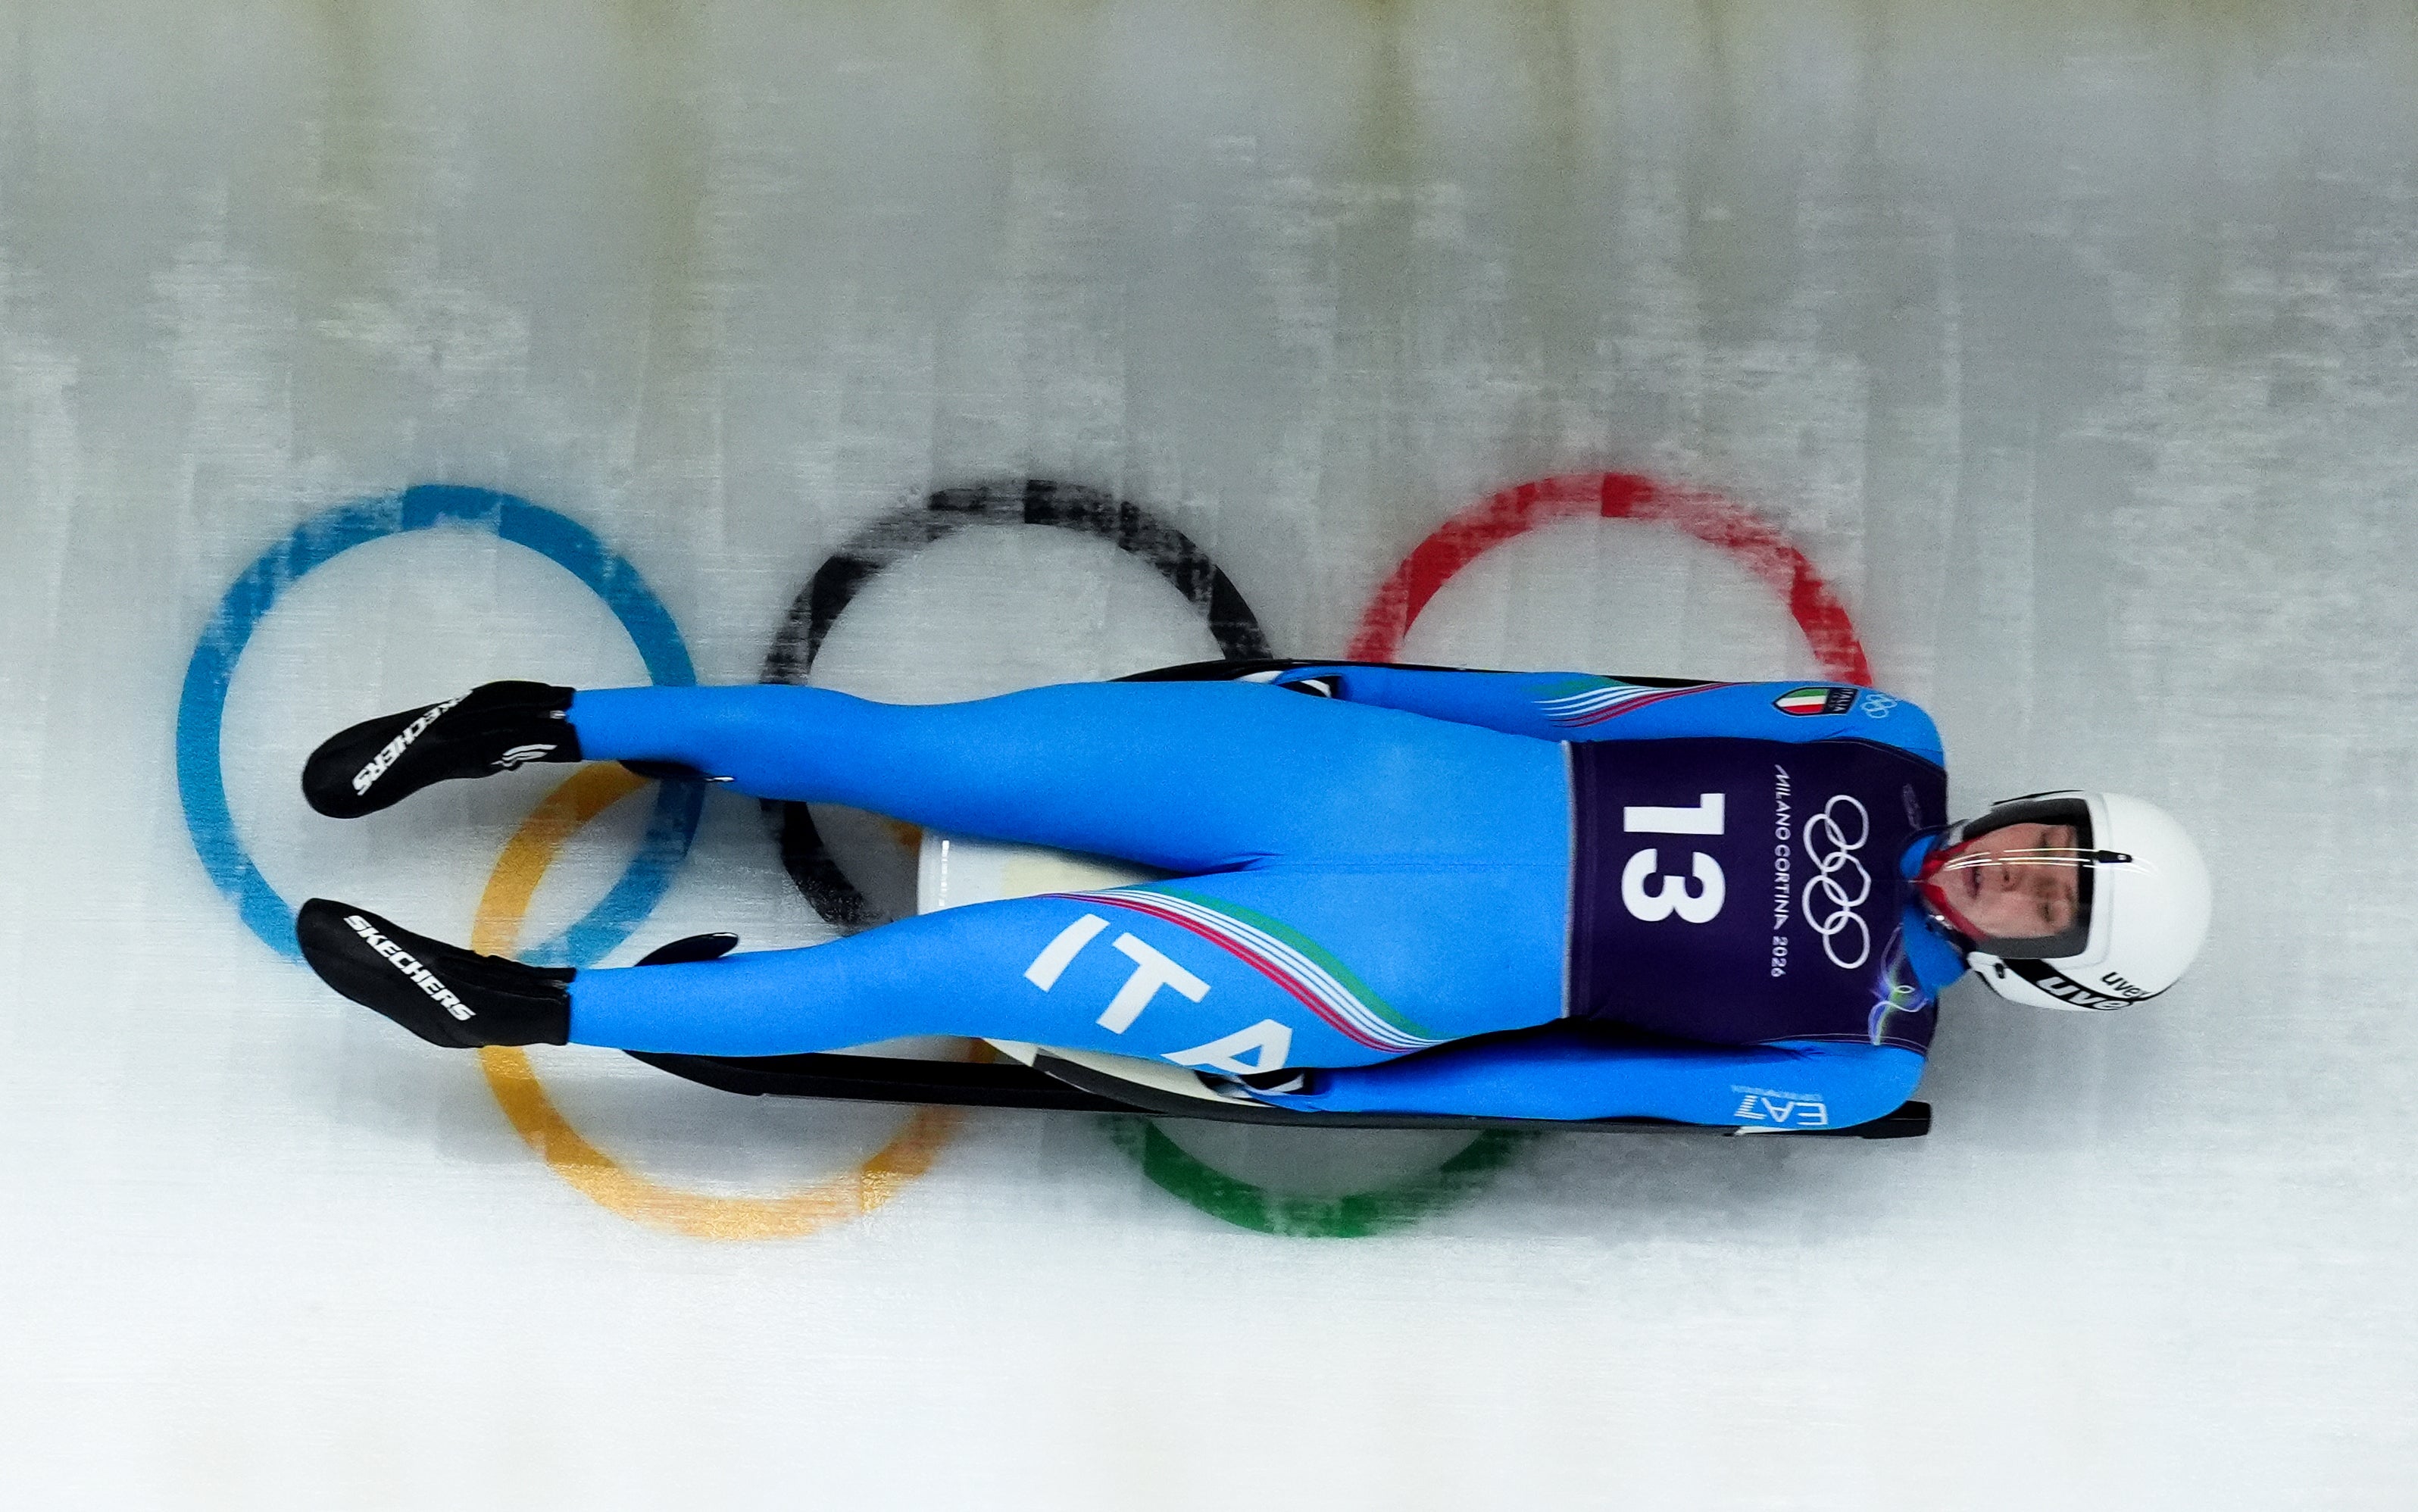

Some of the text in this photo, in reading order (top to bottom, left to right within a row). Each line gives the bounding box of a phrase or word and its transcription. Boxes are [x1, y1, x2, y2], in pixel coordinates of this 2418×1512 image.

[1621, 792, 1726, 924] 13
[1770, 764, 1792, 977] MILANO CORTINA 2026
[342, 914, 476, 1021] SKECHERS
[1024, 913, 1292, 1075] ITA
[2035, 976, 2131, 1011] uve
[1733, 1094, 1829, 1126] EA7
